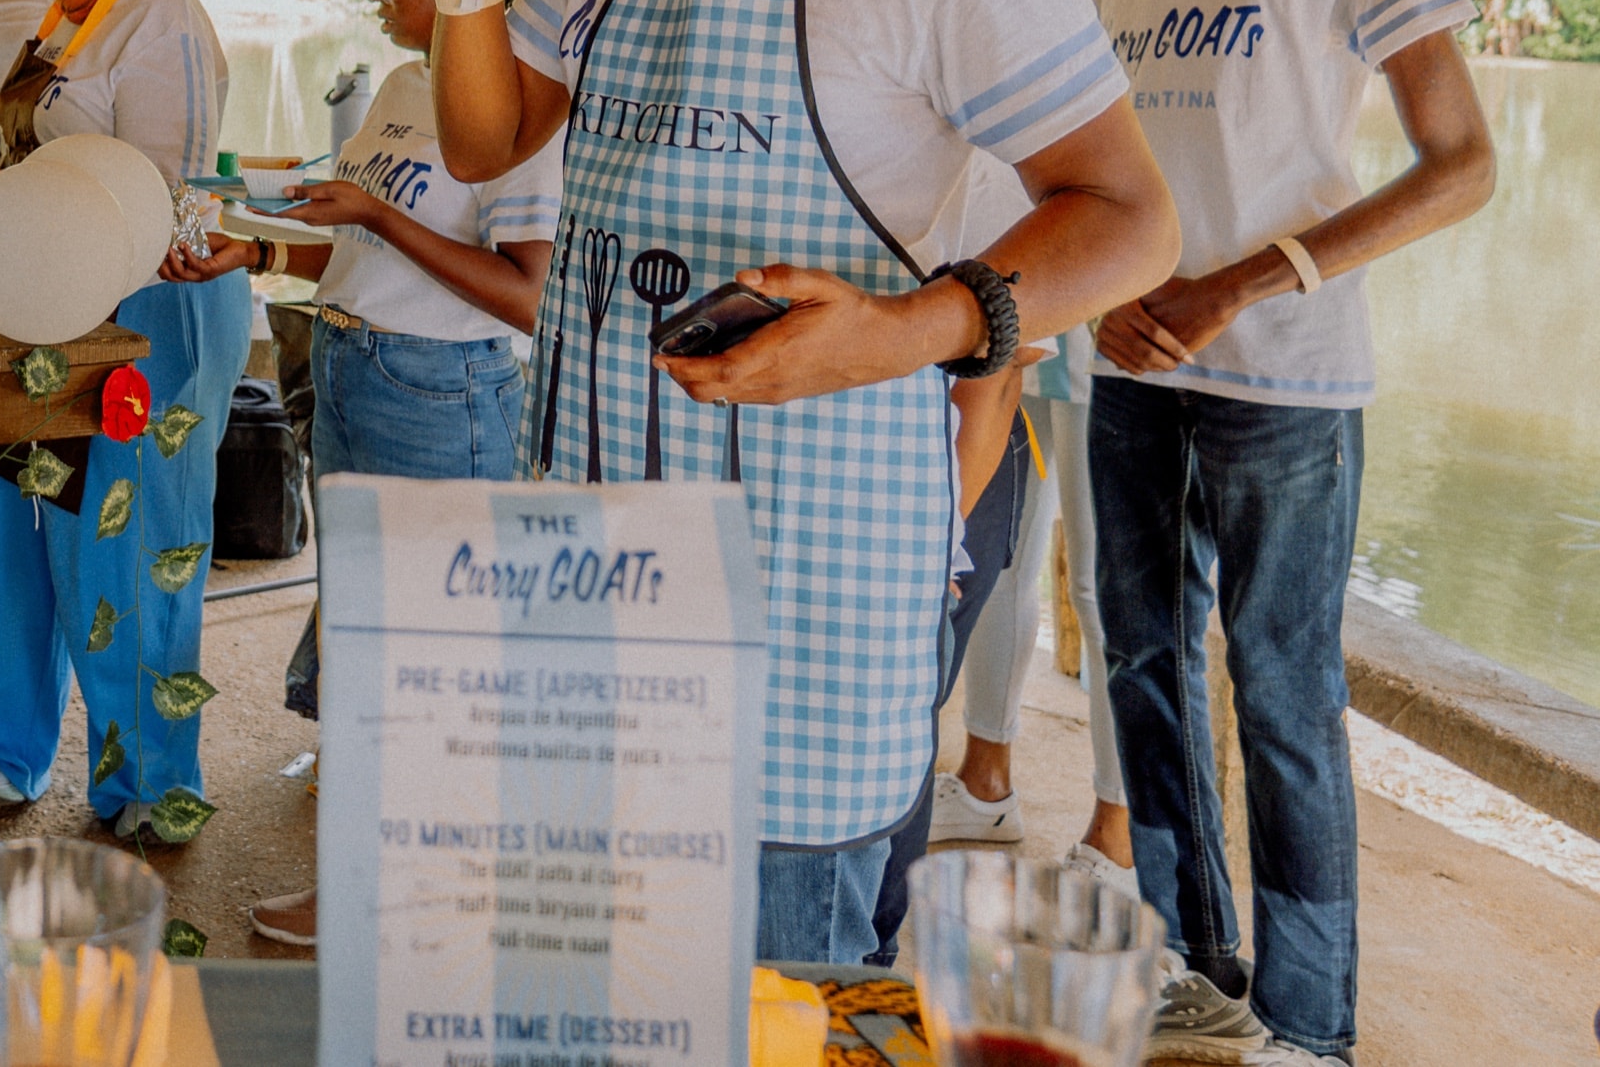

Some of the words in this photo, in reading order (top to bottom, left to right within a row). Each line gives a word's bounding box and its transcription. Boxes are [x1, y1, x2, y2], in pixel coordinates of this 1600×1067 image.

[380, 123, 414, 139] THE
[573, 91, 781, 155] KITCHEN
[517, 513, 579, 535] THE
[444, 540, 540, 617] Curry
[397, 667, 528, 696] PRE-GAME
[379, 818, 410, 845] 90
[419, 820, 525, 851] MINUTES
[406, 1011, 484, 1041] EXTRA
[493, 1013, 549, 1043] TIME
